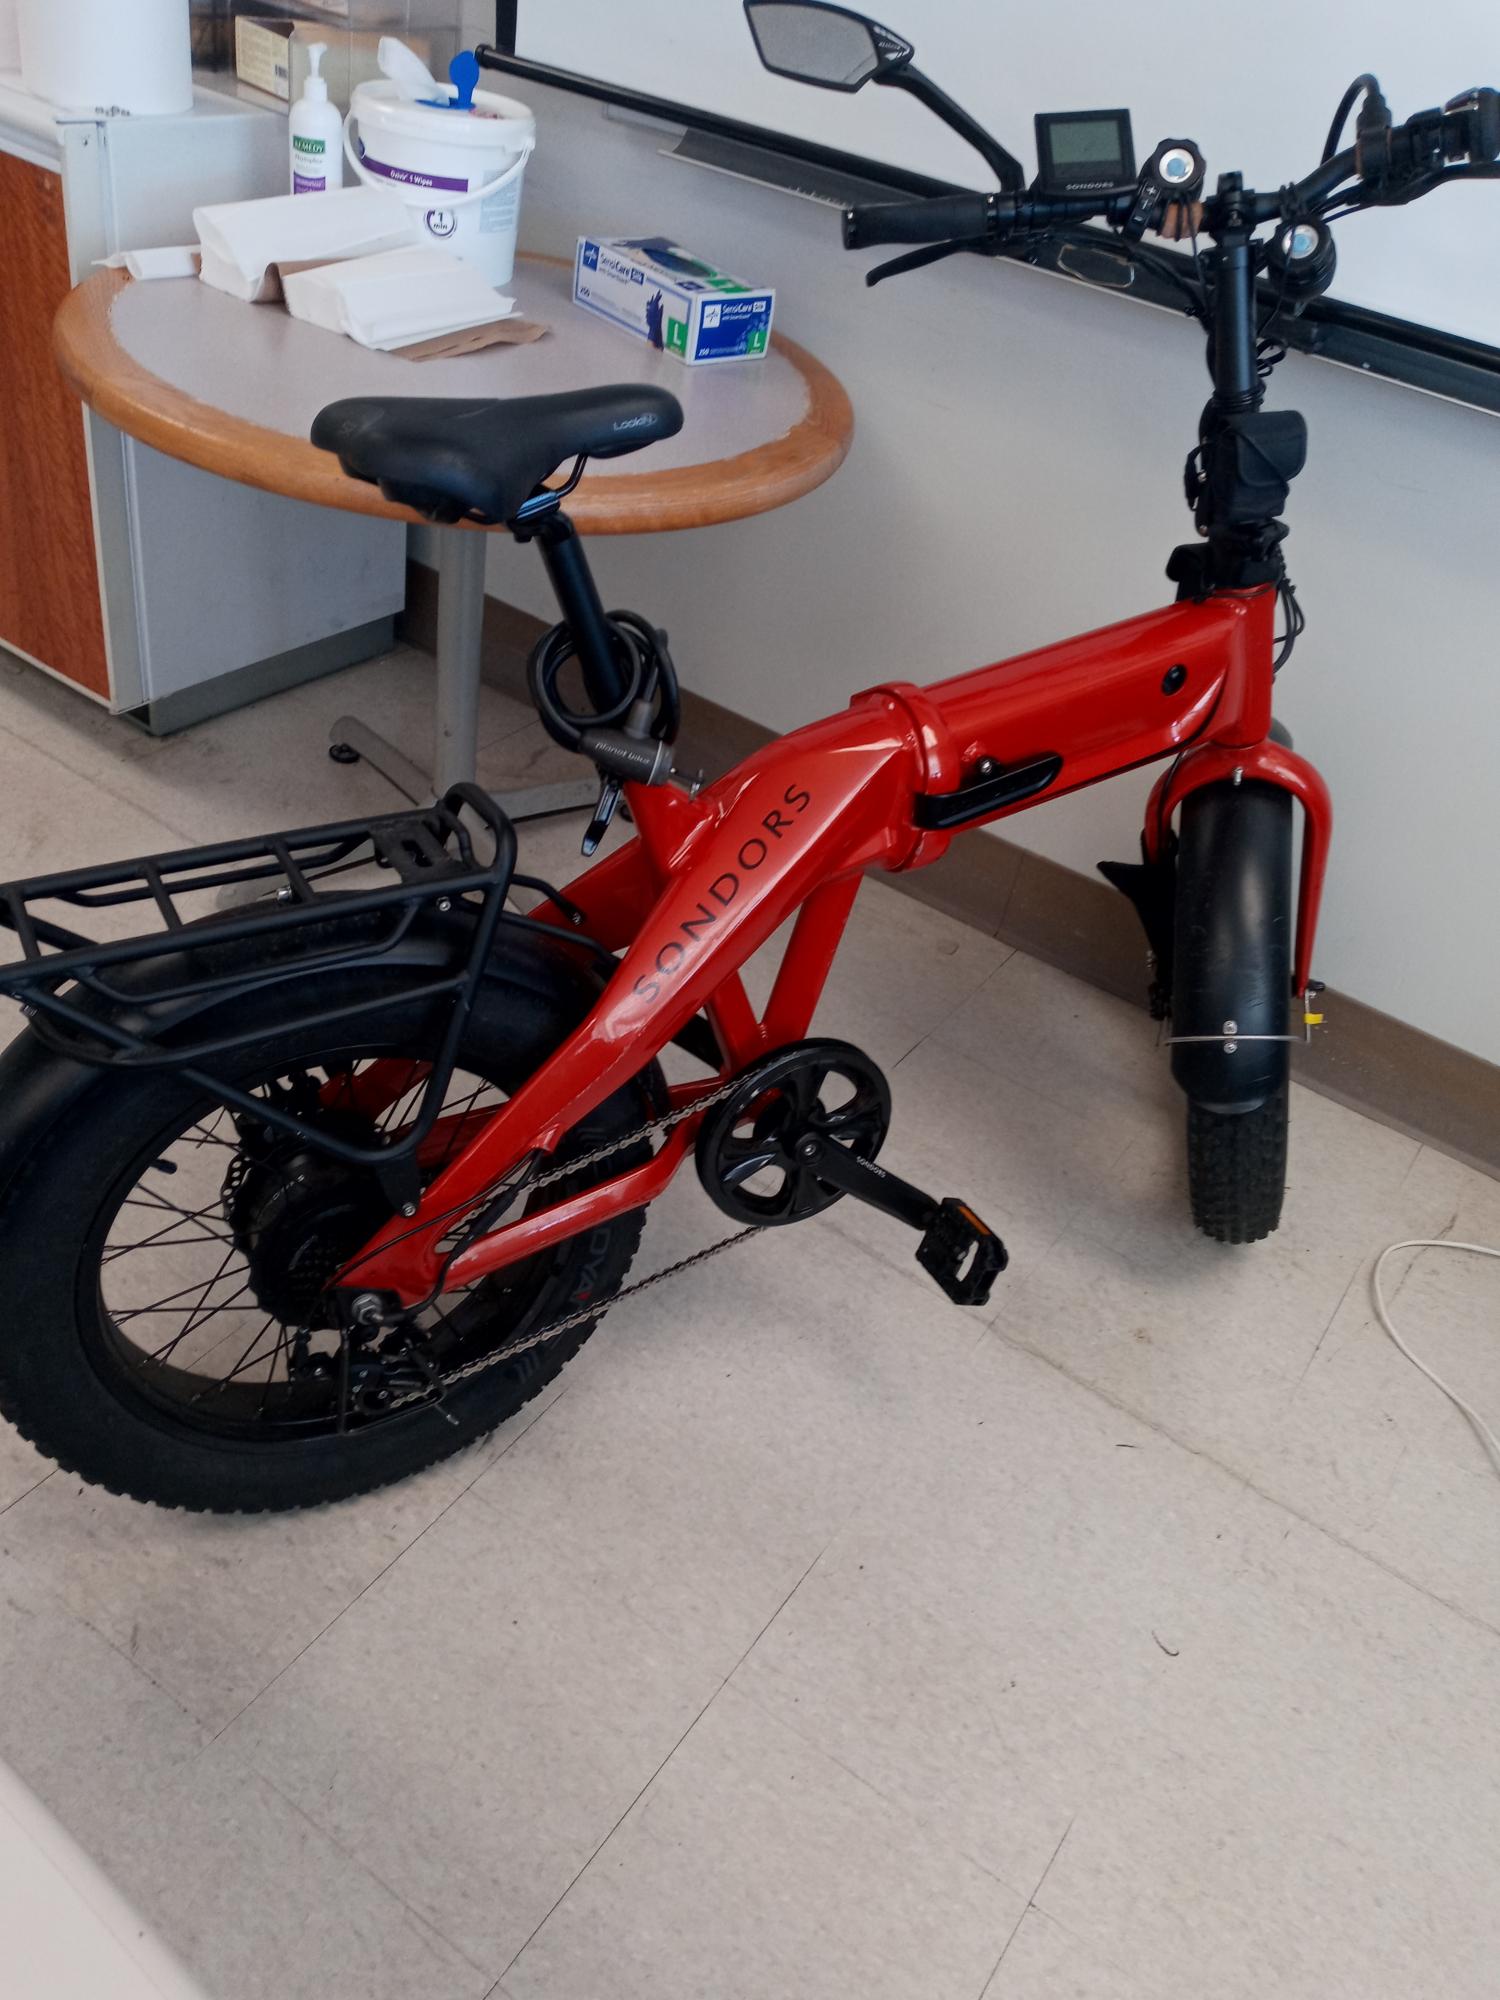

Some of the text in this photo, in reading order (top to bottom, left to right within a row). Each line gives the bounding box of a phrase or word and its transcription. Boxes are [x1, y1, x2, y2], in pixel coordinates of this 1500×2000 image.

[438, 211, 443, 223] 1
[433, 223, 448, 231] min
[723, 303, 753, 315] SensiCare
[673, 322, 682, 346] L
[753, 331, 761, 348] L
[633, 784, 811, 1004] SONDORS
